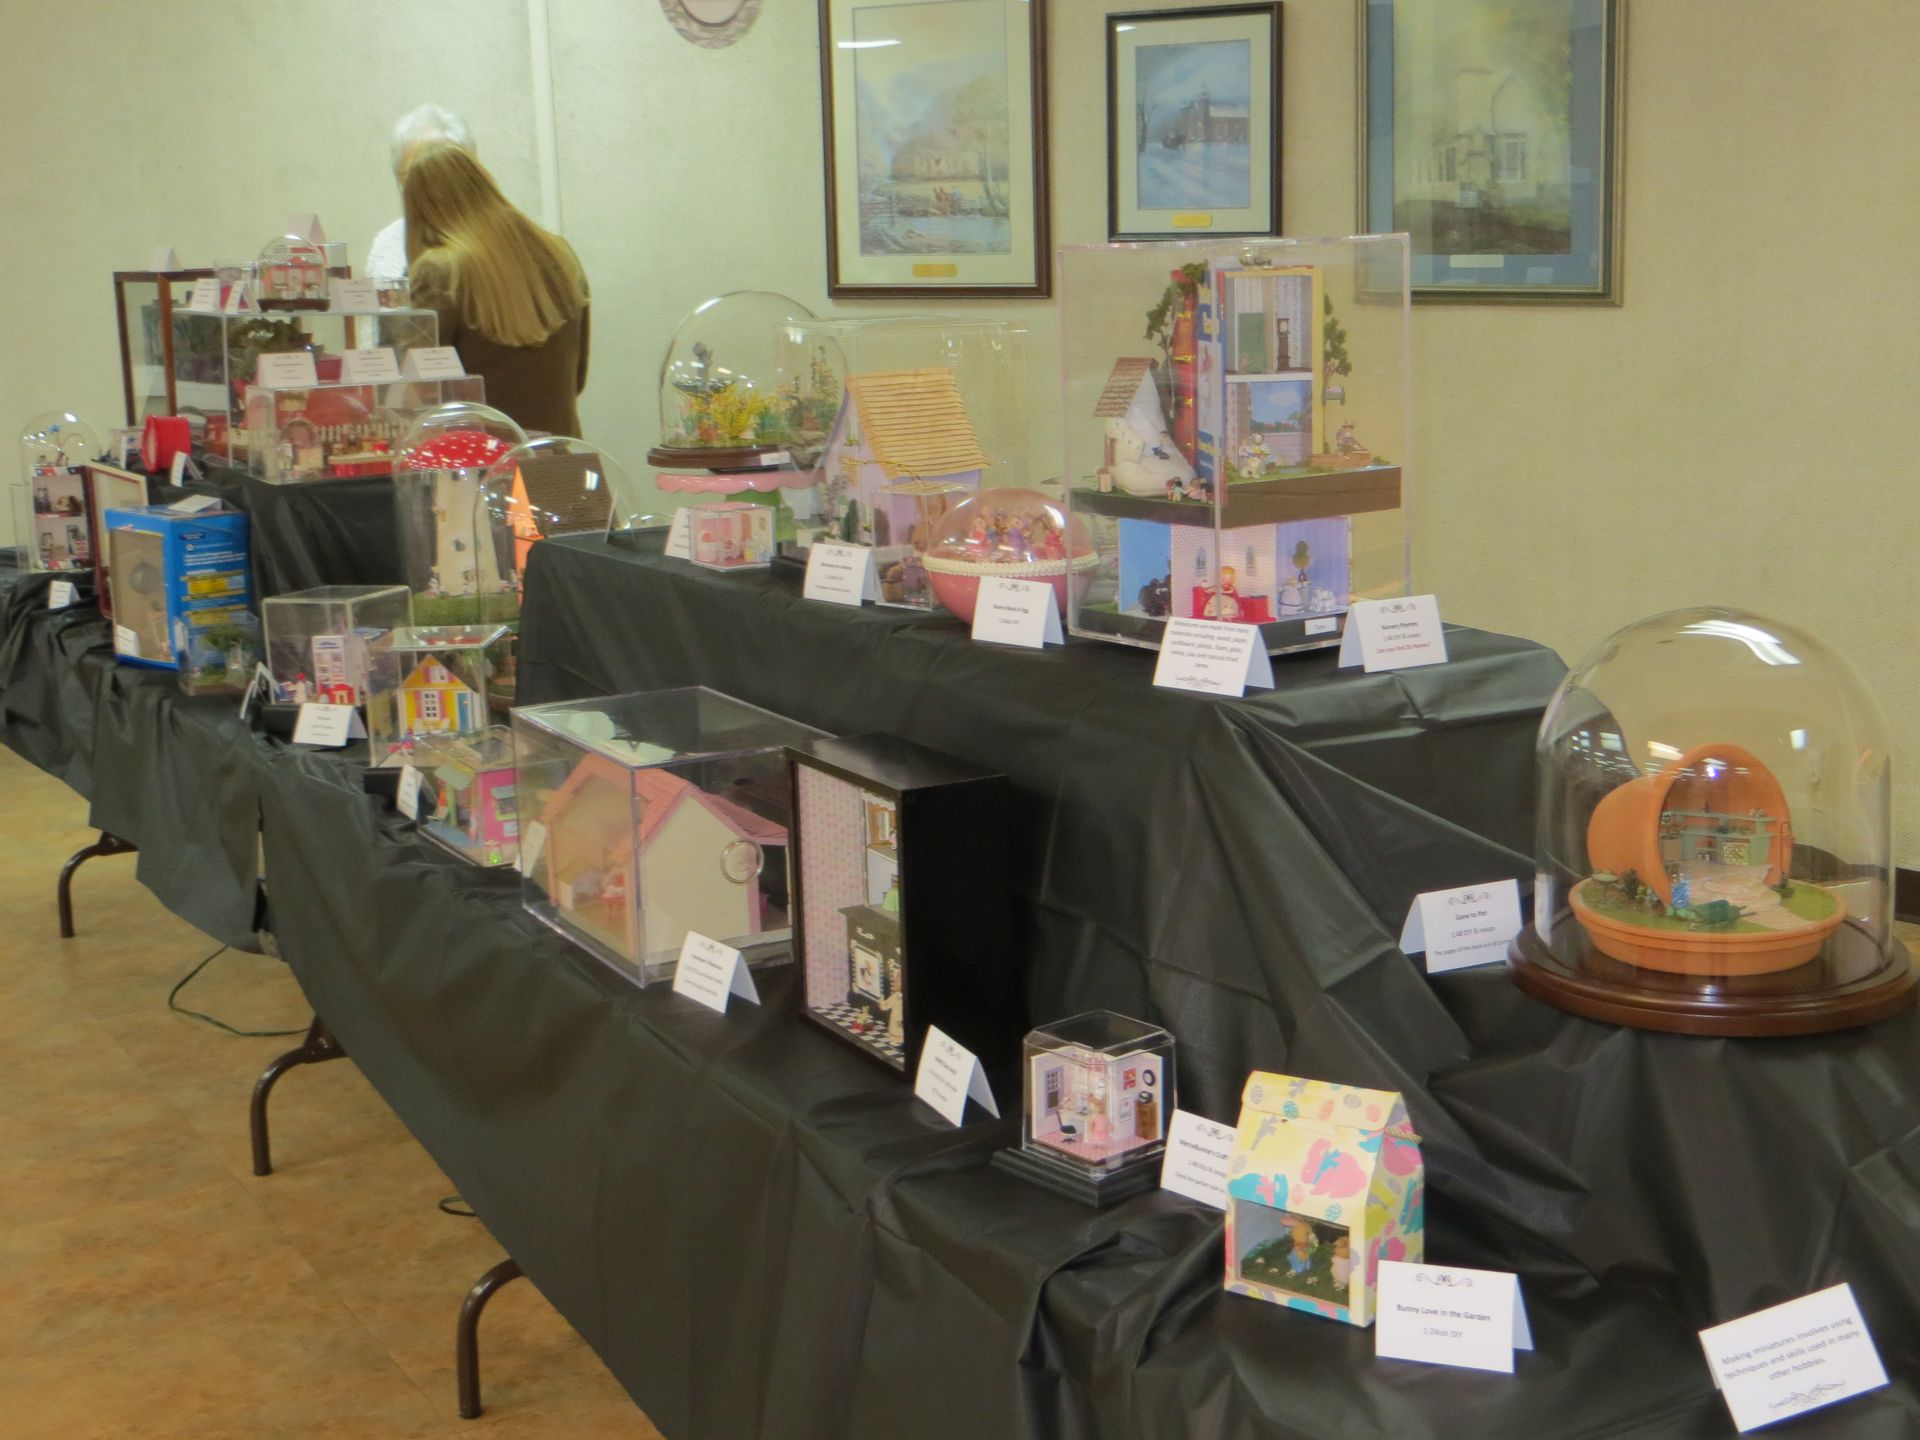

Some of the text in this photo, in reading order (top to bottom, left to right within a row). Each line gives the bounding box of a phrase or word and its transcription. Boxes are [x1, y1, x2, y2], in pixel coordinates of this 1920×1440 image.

[1397, 1304, 1419, 1314] Bunny
[1463, 1312, 1491, 1321] Garden
[1722, 1318, 1852, 1364] Making miniatures involves using
[1725, 1361, 1768, 1379] techniques
[1770, 1354, 1785, 1364] and
[1787, 1348, 1806, 1359] skills
[1807, 1341, 1826, 1352] used
[1837, 1331, 1860, 1342] many
[1769, 1358, 1825, 1380] other hobbies.
